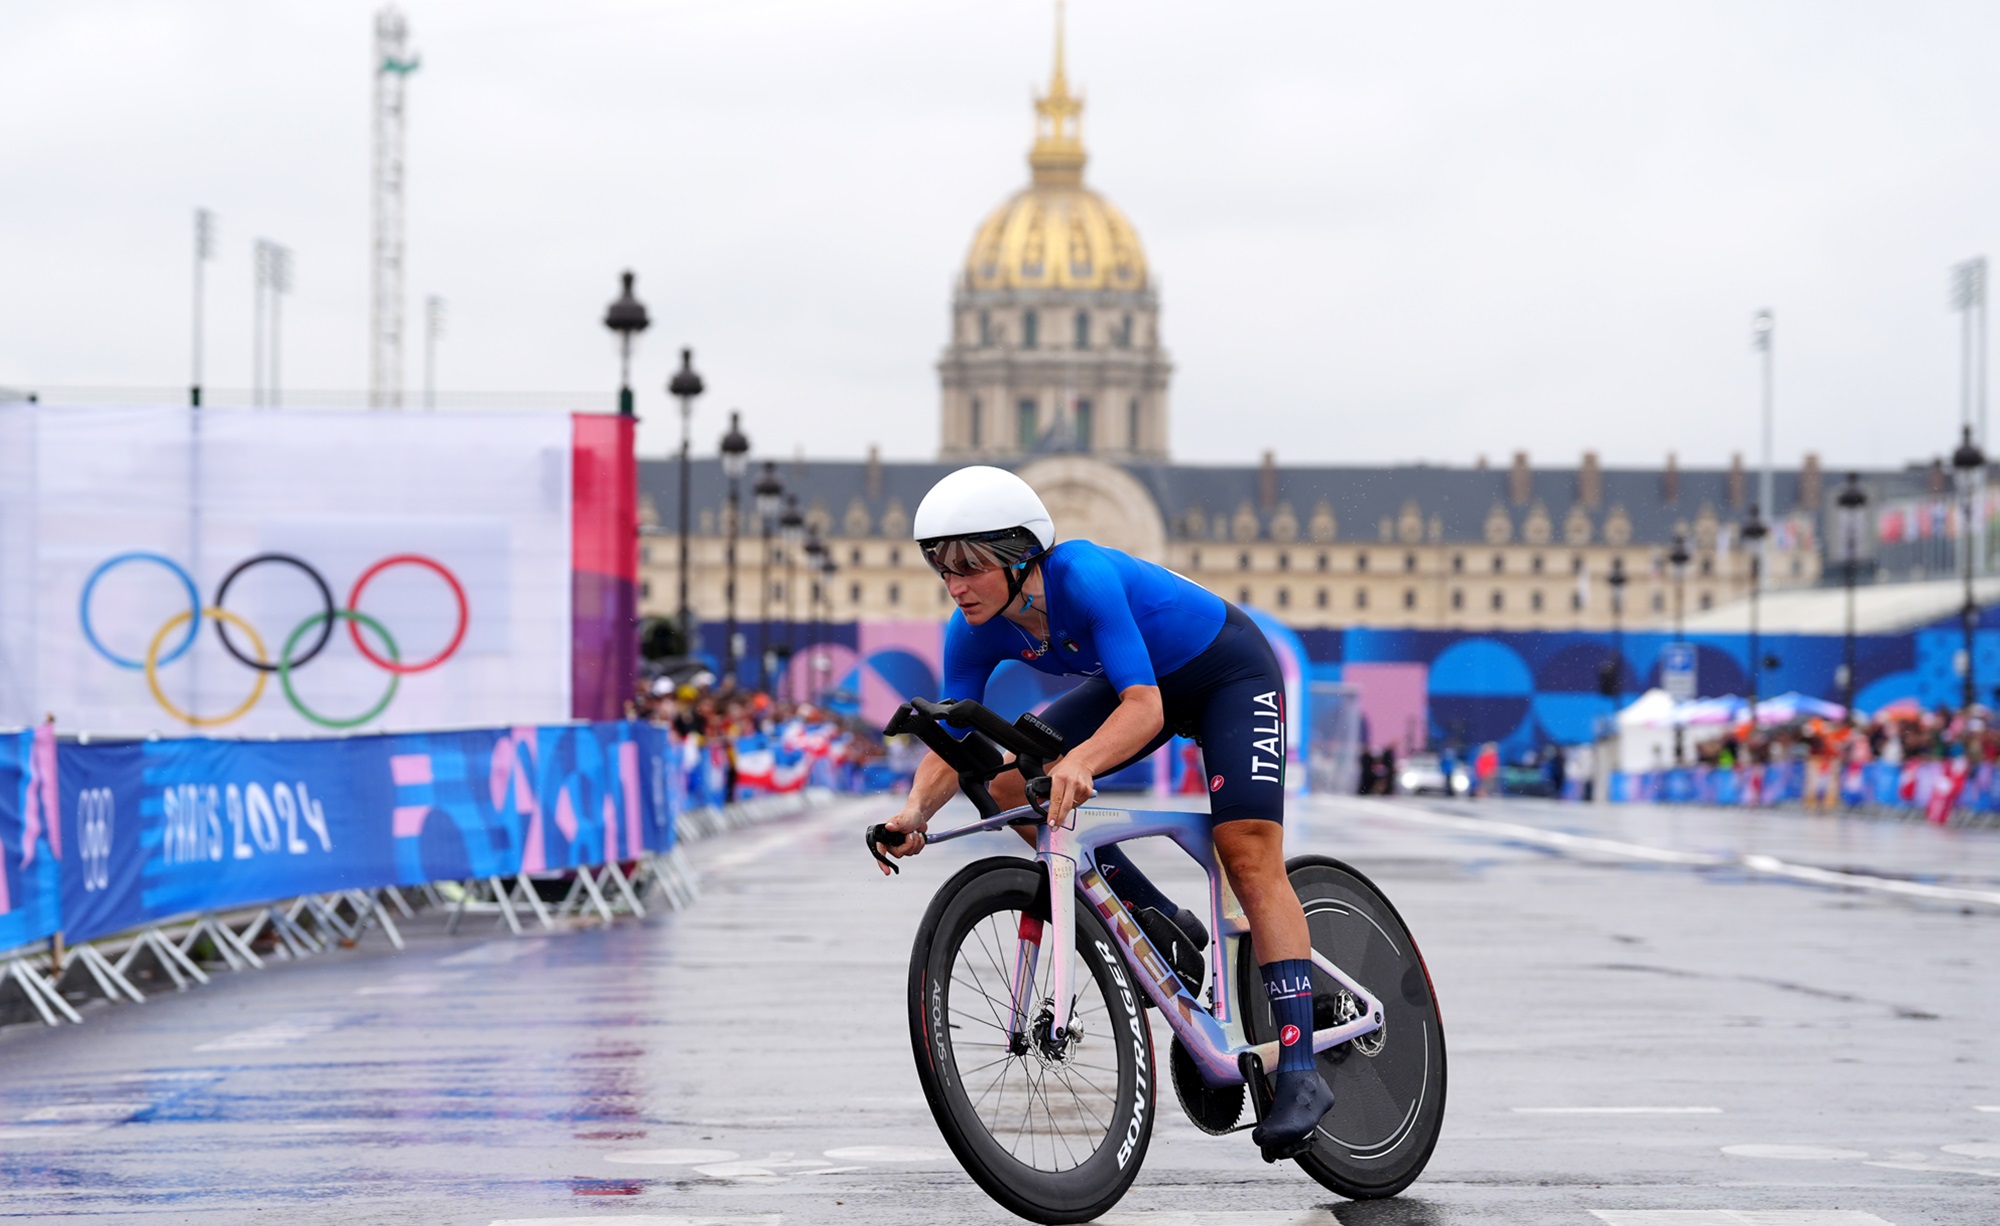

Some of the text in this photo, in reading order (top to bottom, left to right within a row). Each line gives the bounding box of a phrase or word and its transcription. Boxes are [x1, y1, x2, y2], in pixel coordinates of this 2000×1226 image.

[1251, 690, 1280, 784] ITALIA
[163, 780, 333, 866] PARIS 2024
[1080, 869, 1207, 1027] TREK
[1263, 975, 1312, 996] TALIA
[932, 978, 948, 1061] AEOLUS
[1095, 940, 1147, 1171] BONTRAGER
